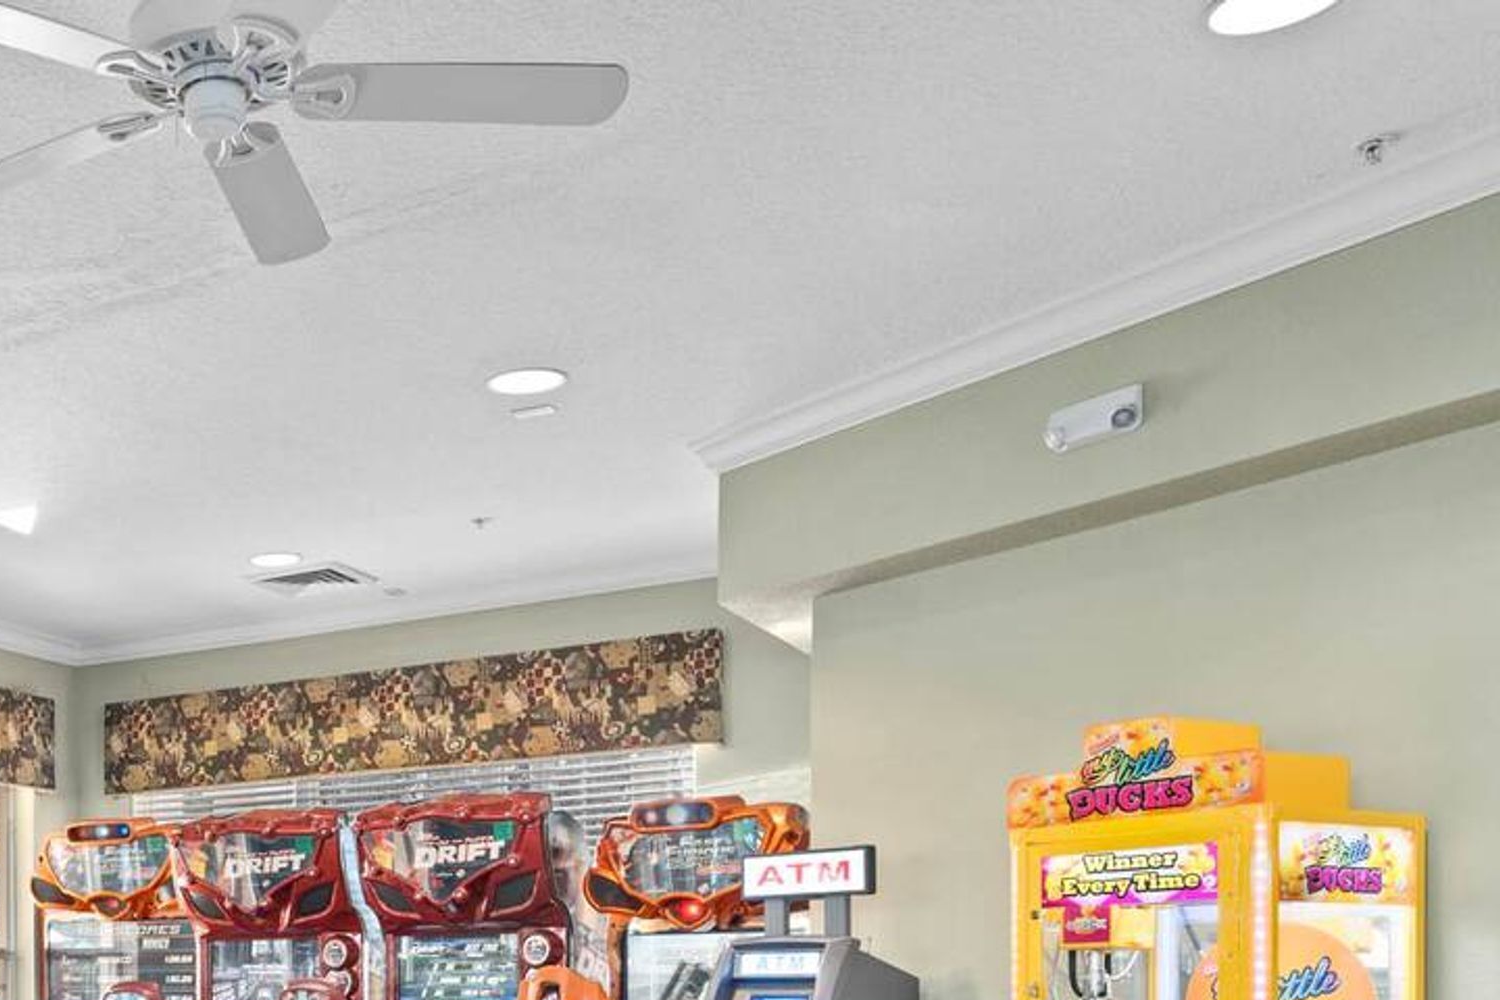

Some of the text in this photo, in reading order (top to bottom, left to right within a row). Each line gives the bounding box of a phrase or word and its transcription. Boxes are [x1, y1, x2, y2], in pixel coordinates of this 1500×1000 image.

[1066, 775, 1194, 821] DUCKS
[223, 853, 305, 878] DRIFT
[414, 840, 505, 869] DRIFT
[1084, 851, 1178, 873] Winner
[756, 860, 852, 888] ATM
[1062, 872, 1201, 898] Every Time
[1305, 865, 1382, 895] DUCKS
[757, 955, 805, 969] ATM
